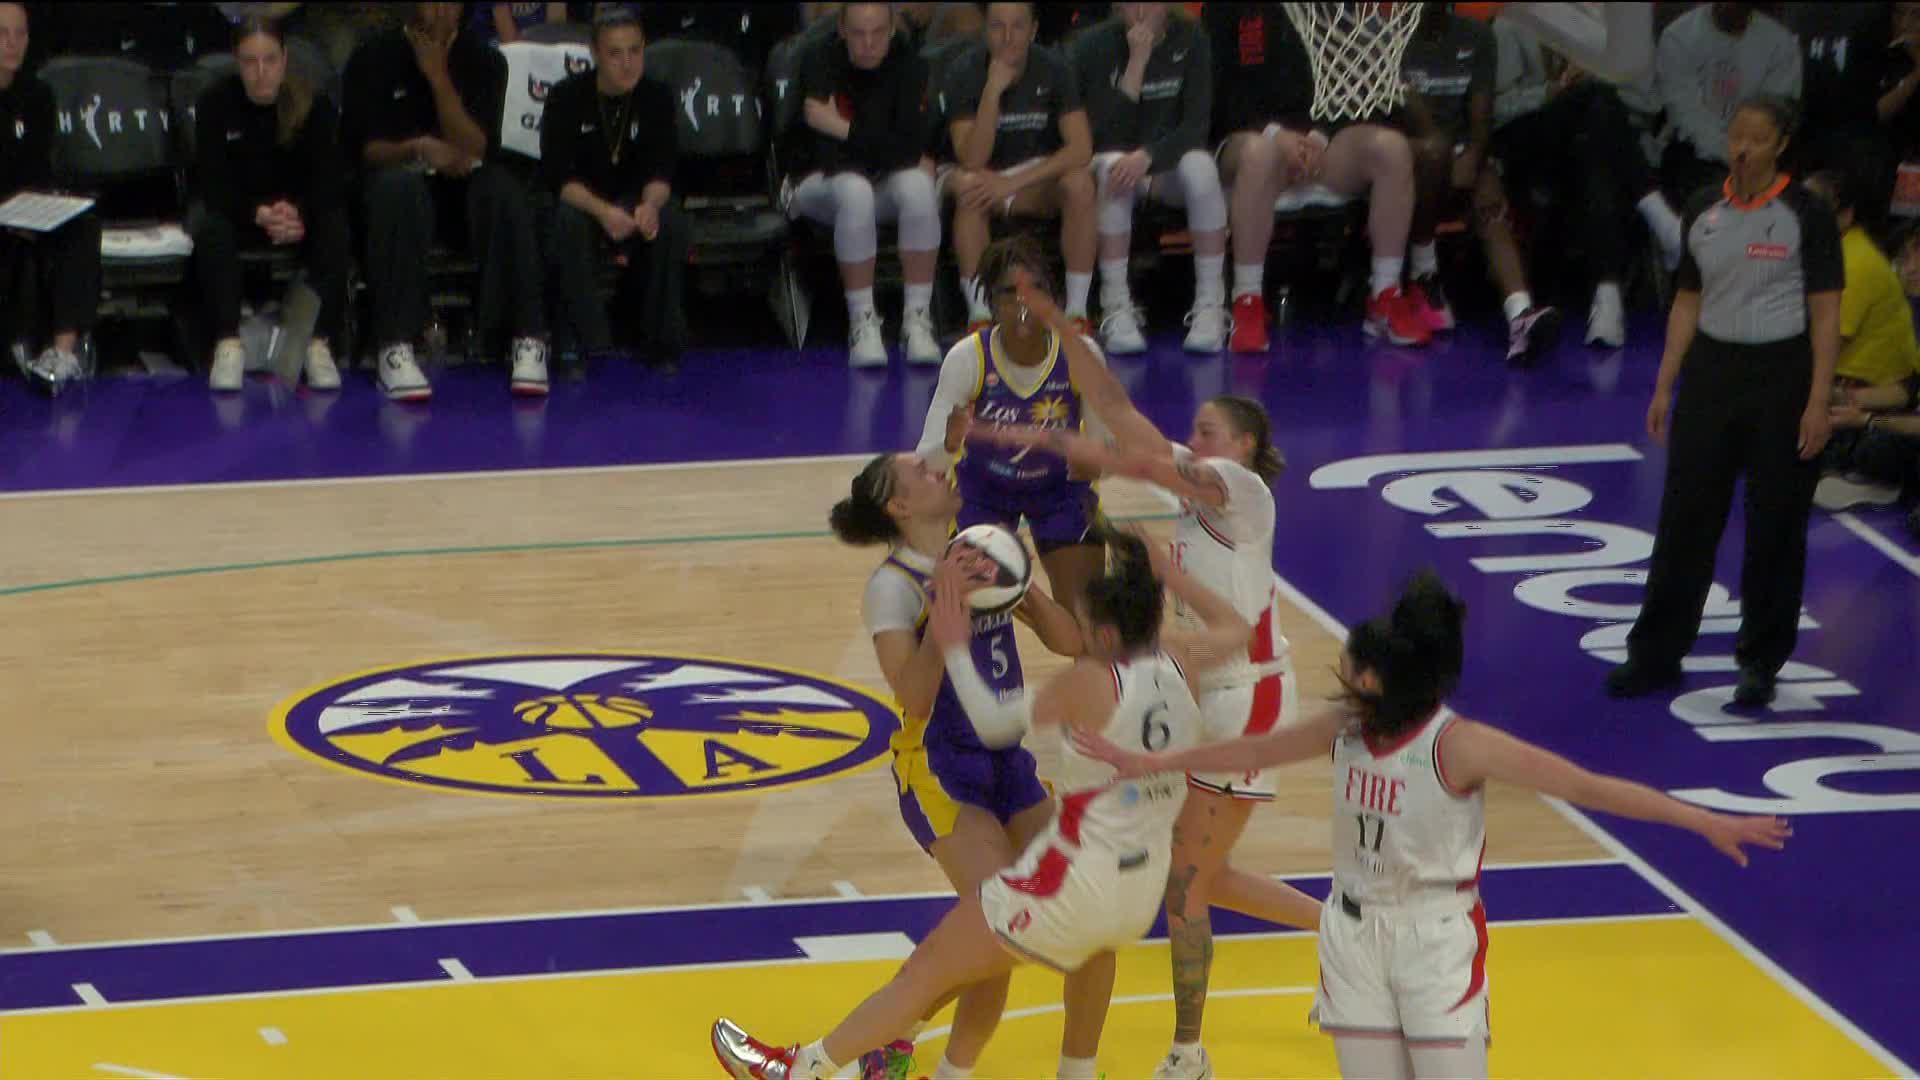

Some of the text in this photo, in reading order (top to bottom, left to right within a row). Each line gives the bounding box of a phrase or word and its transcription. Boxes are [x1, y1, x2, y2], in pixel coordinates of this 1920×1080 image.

[991, 634, 1009, 680] 5
[1142, 701, 1172, 753] 6
[1345, 765, 1406, 817] FIRE
[1357, 811, 1385, 852] 17
